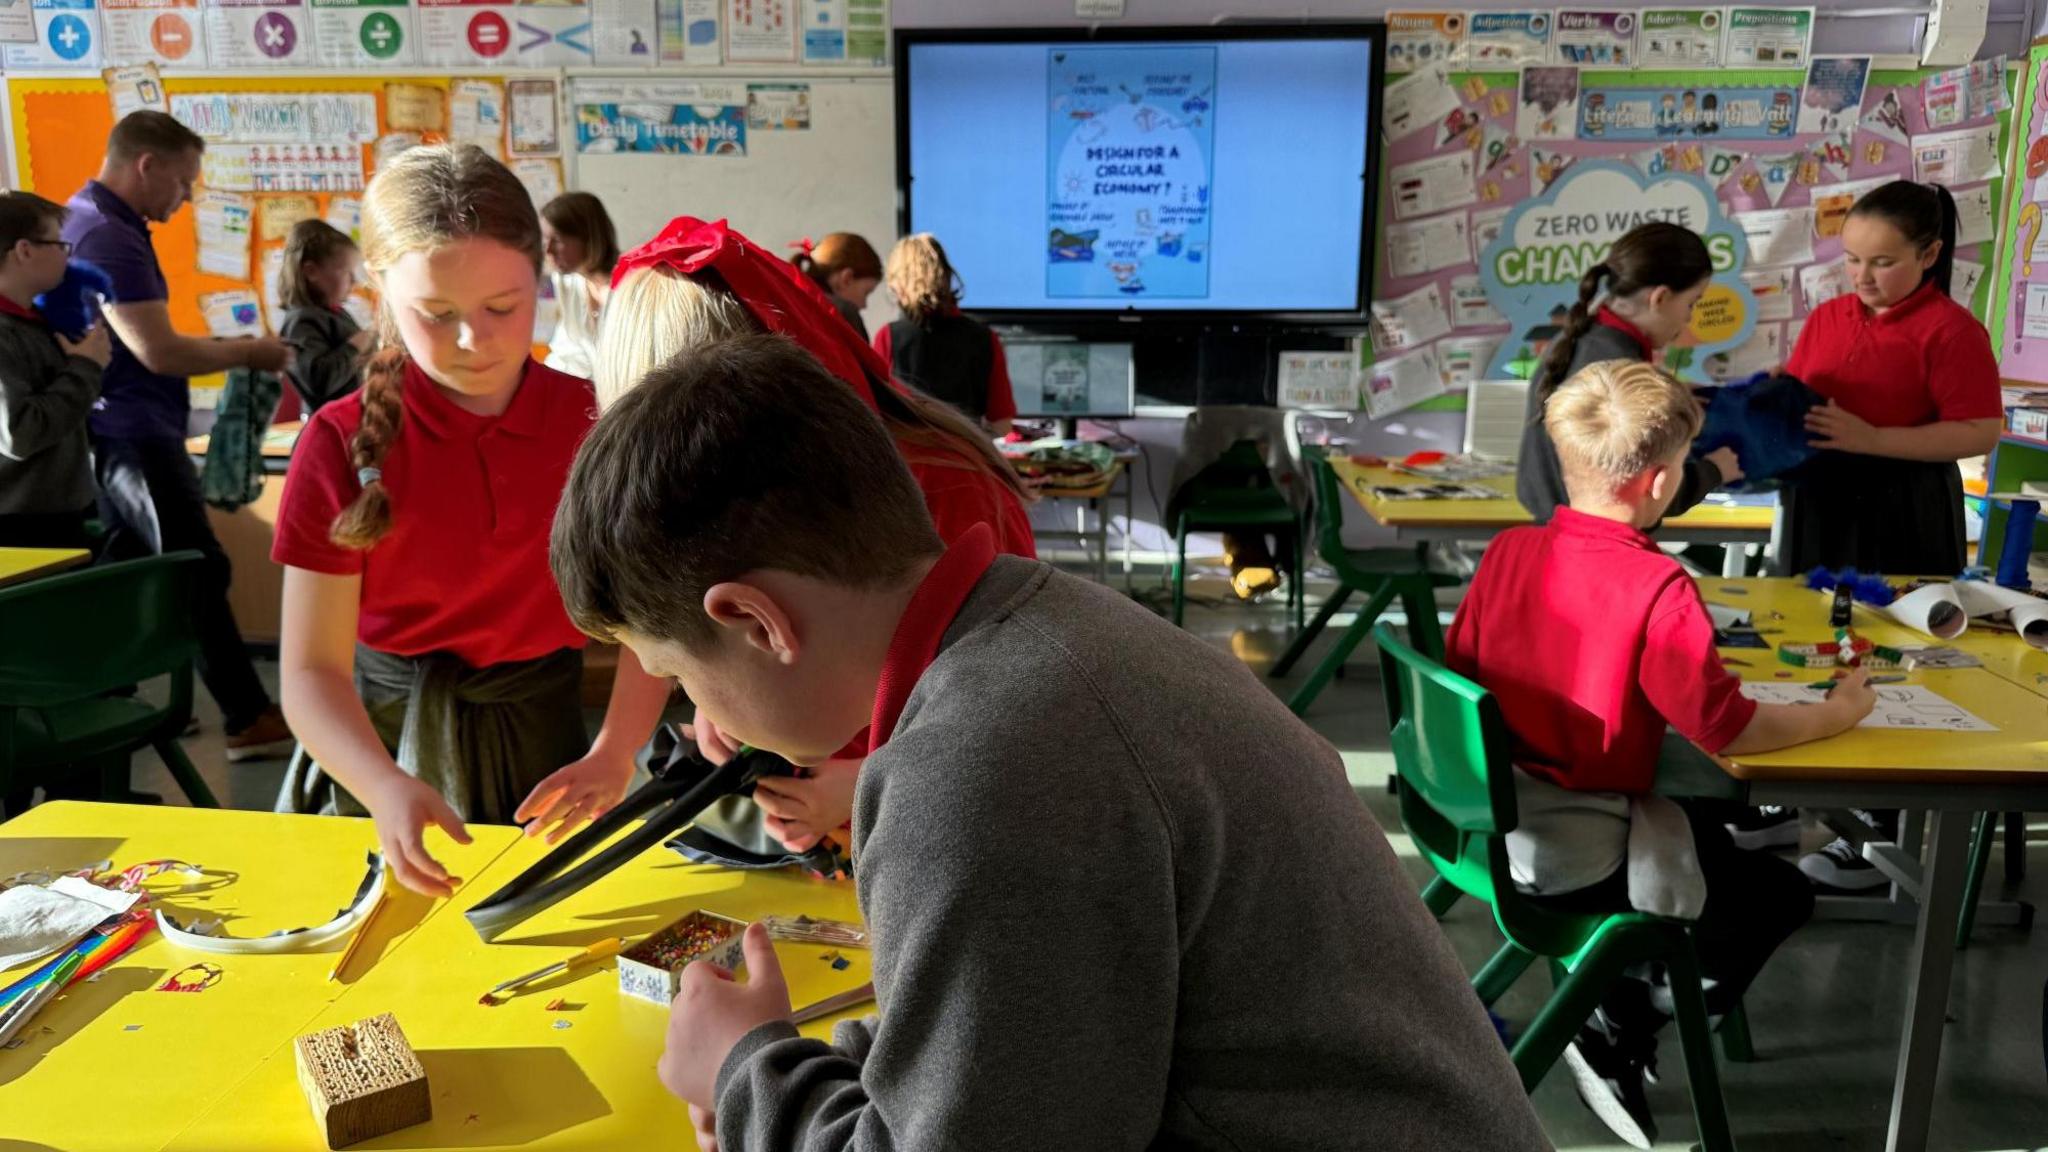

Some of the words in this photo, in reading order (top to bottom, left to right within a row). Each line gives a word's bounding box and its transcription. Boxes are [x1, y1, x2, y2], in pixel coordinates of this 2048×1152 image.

[1390, 15, 1434, 28] Nouns
[1474, 15, 1527, 29] Adjectives
[1561, 14, 1600, 28] Verbs
[1647, 14, 1688, 25] Adverbs
[1734, 13, 1798, 25] Prepositions
[587, 119, 638, 142] Daily
[643, 120, 738, 140] Timetable
[1086, 147, 1135, 161] DESIGN
[1136, 147, 1165, 160] FOR
[1168, 146, 1181, 160] A
[1095, 163, 1165, 178] CIRCULAR
[1709, 154, 1730, 175] D
[1535, 213, 1598, 238] ZERO
[1604, 206, 1692, 232] WASTE
